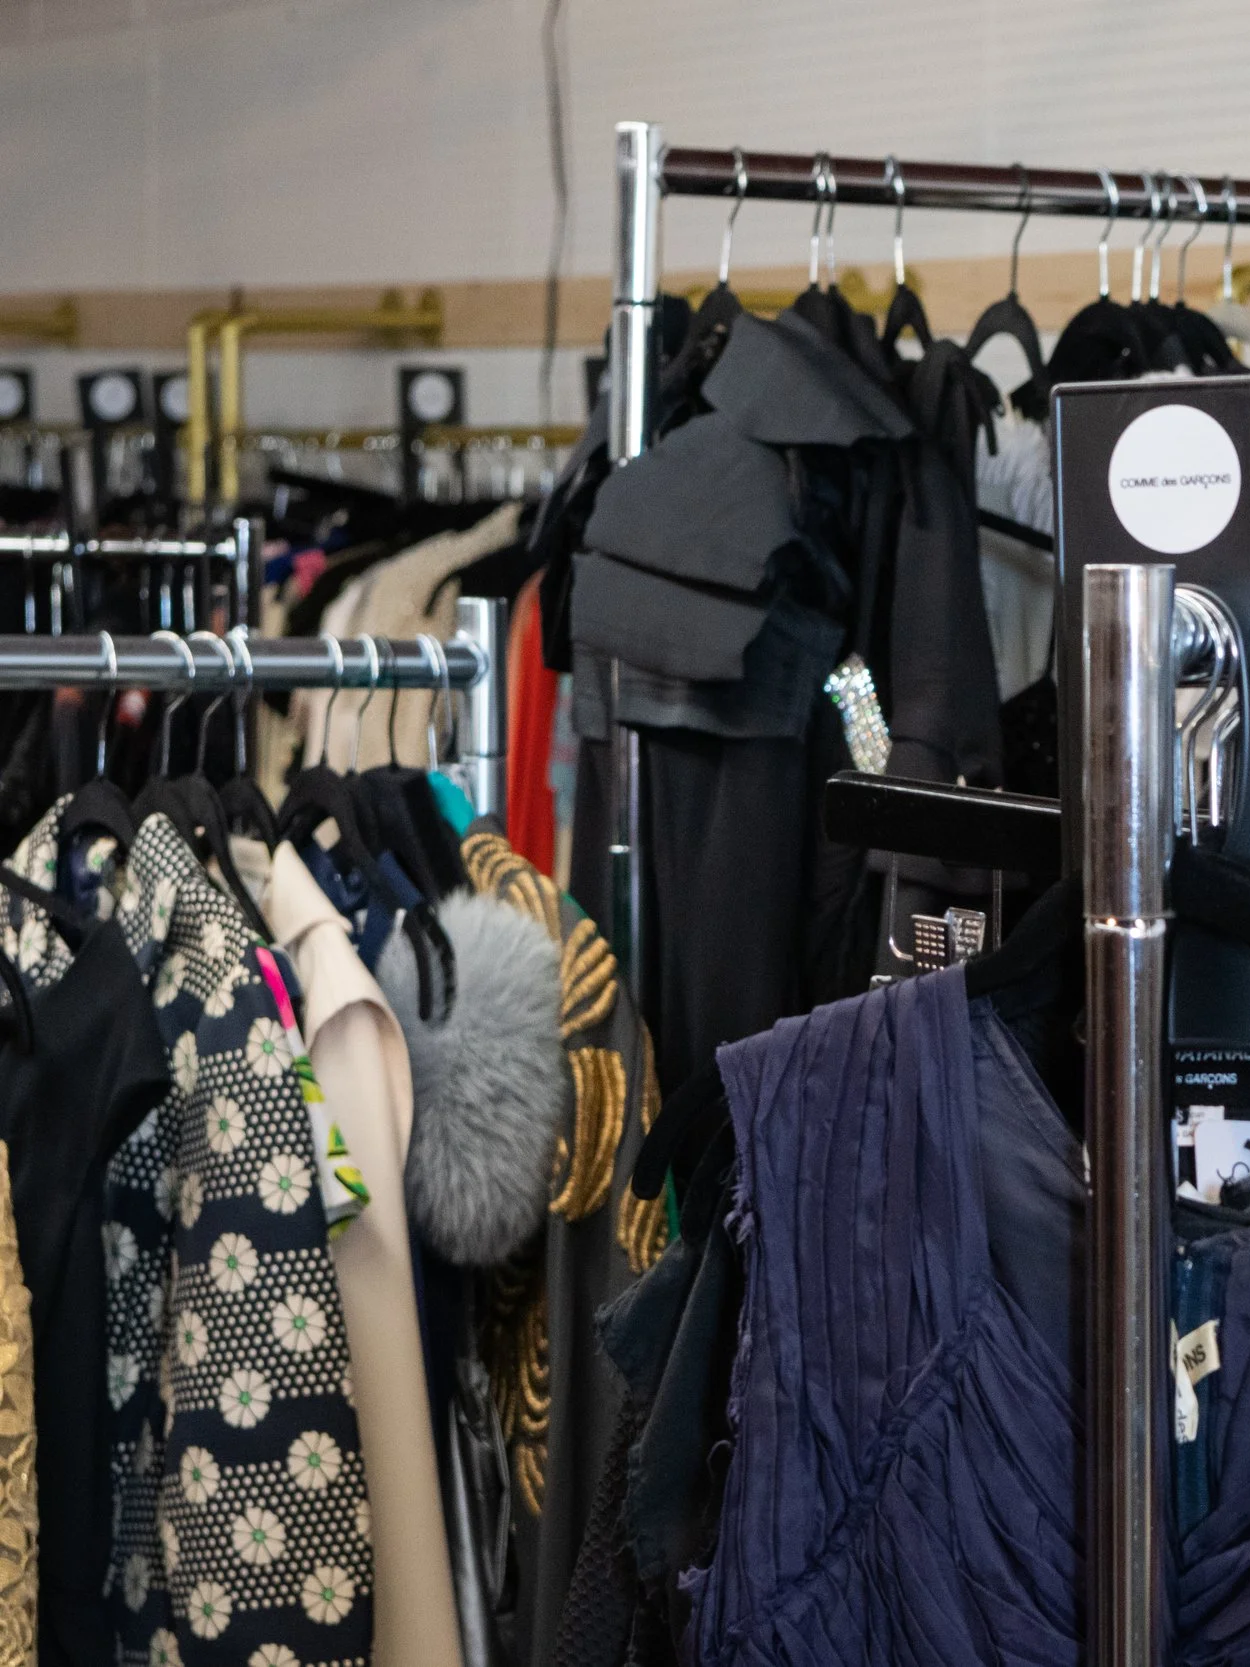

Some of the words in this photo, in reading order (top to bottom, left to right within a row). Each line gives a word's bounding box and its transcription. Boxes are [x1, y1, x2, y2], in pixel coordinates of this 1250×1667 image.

[1120, 476, 1158, 488] COMME
[1162, 477, 1177, 486] des
[1180, 473, 1231, 489] GARÇONS
[1185, 1072, 1238, 1089] GARÇONS
